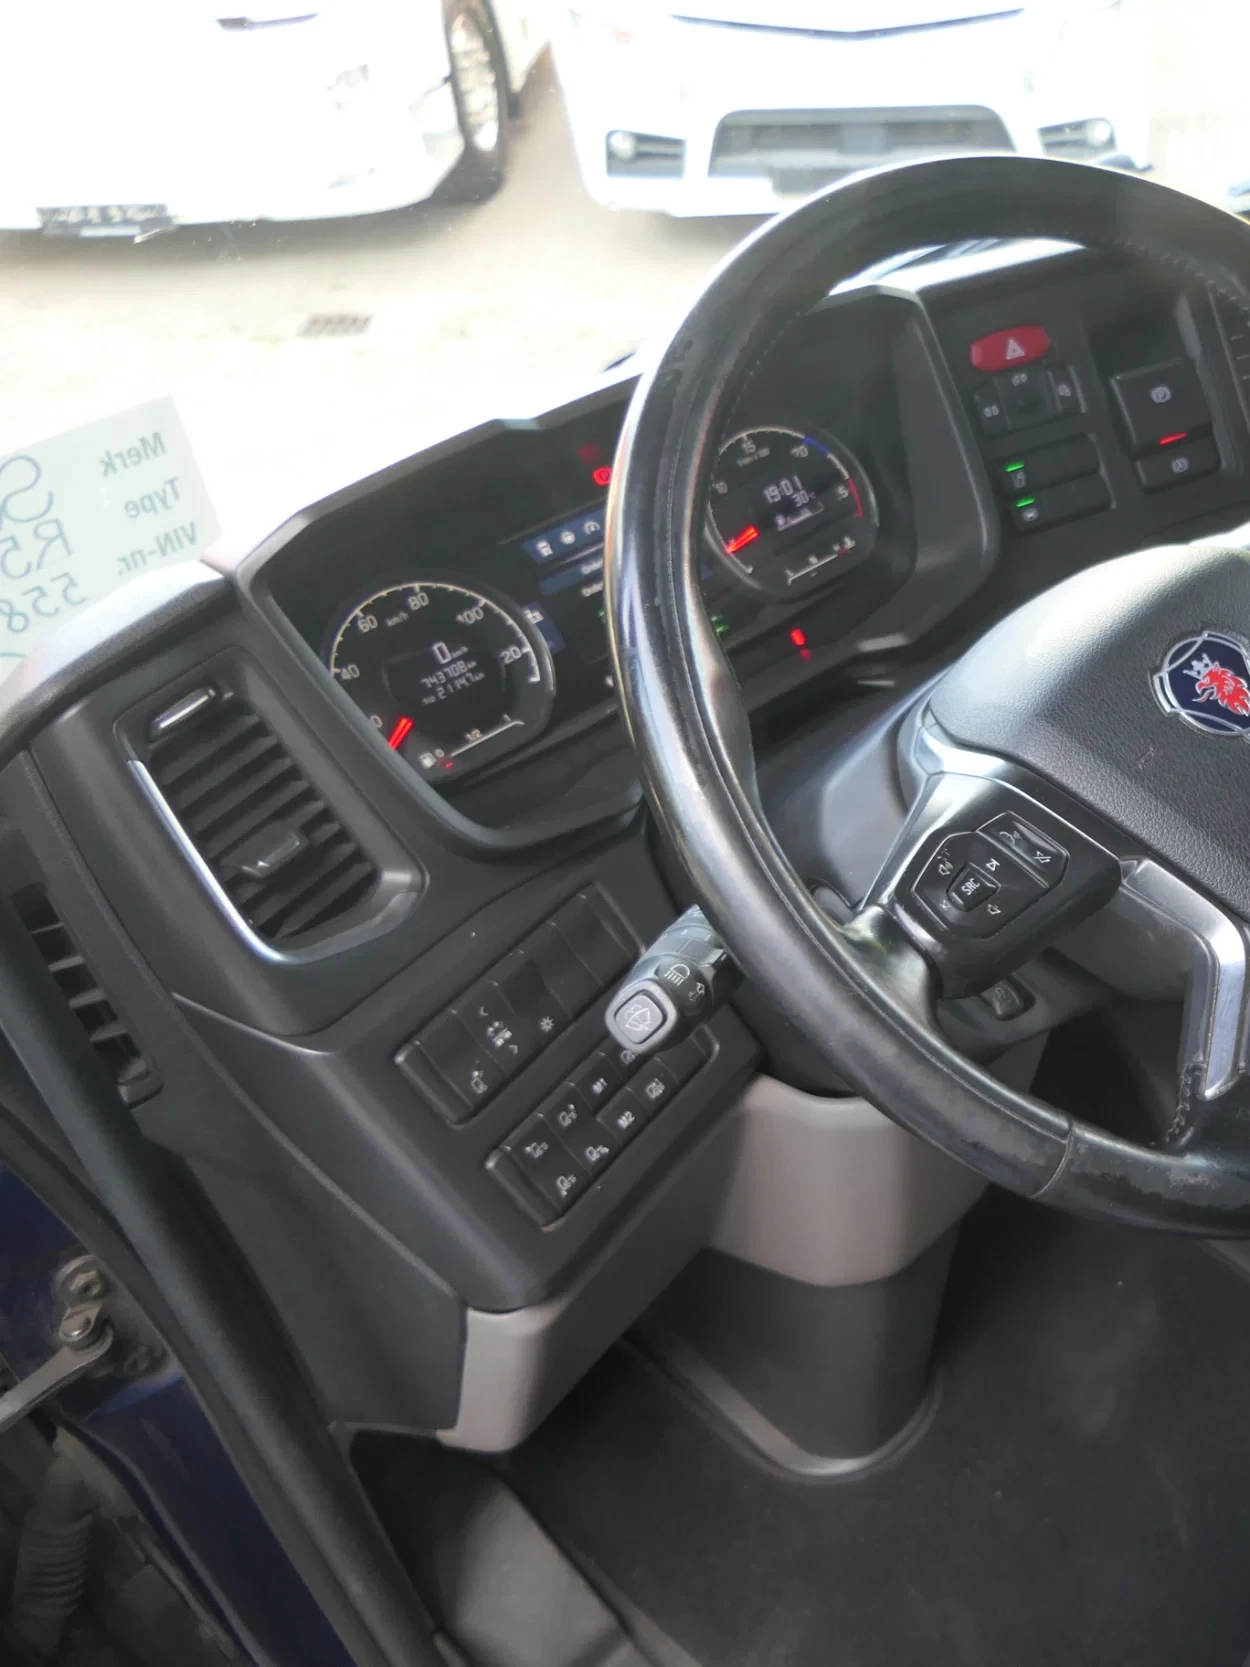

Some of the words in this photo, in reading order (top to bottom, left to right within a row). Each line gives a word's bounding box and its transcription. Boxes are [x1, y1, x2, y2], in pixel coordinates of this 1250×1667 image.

[408, 592, 430, 611] 80
[357, 615, 378, 633] 60
[456, 607, 484, 625] 100
[432, 641, 452, 665] 0
[341, 664, 360, 680] 40
[961, 877, 980, 896] SRC
